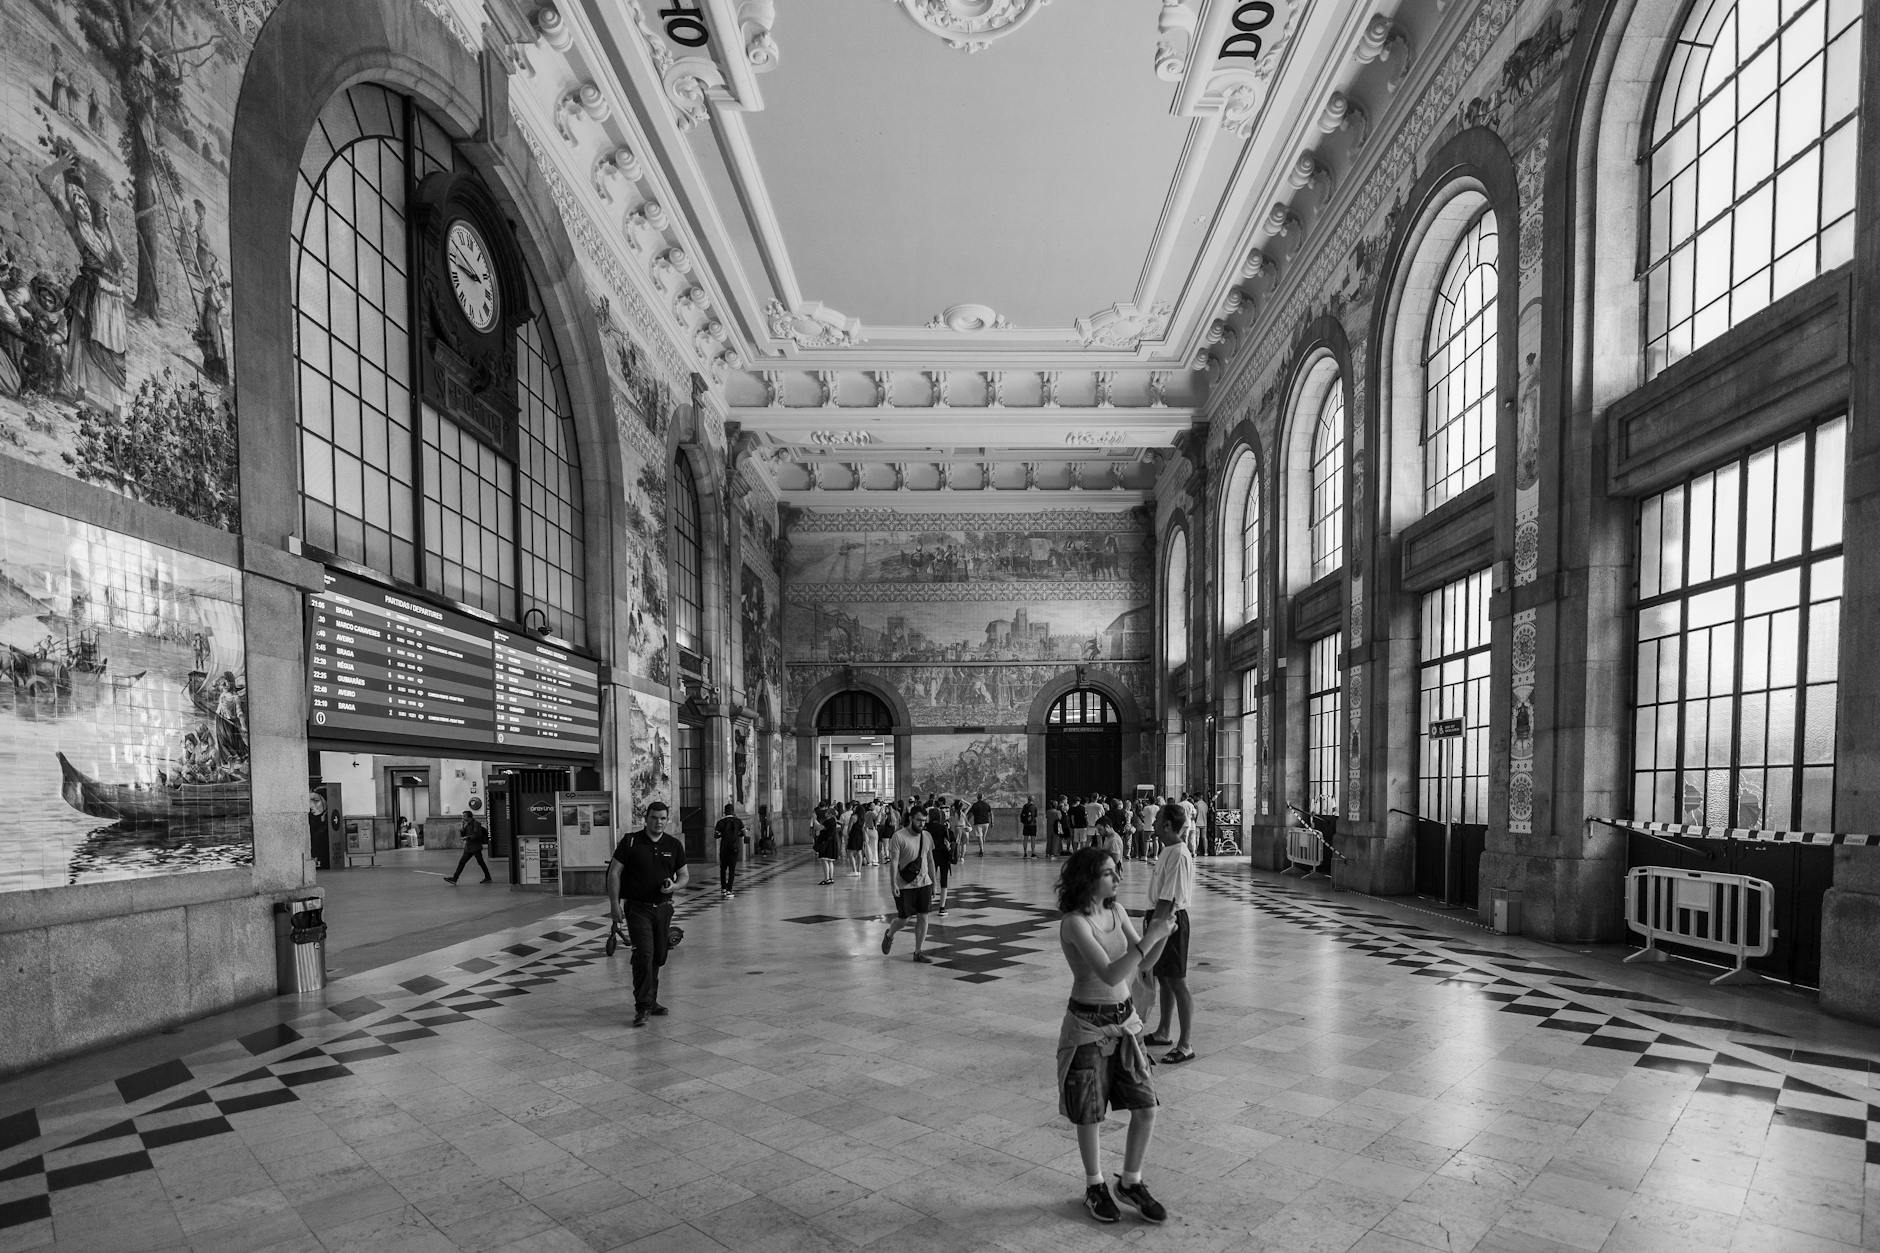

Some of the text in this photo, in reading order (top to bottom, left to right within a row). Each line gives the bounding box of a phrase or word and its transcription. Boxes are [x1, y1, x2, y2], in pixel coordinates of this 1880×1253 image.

[335, 606, 354, 617] BRAGA
[384, 595, 410, 610] PARTIDAS
[412, 604, 443, 620] DEPARTURES
[335, 619, 354, 631] MARCO
[336, 634, 355, 644] AVEIRO
[336, 647, 355, 658] BRAGA
[337, 688, 356, 698] AVEIRO
[337, 702, 356, 711] BRAGA
